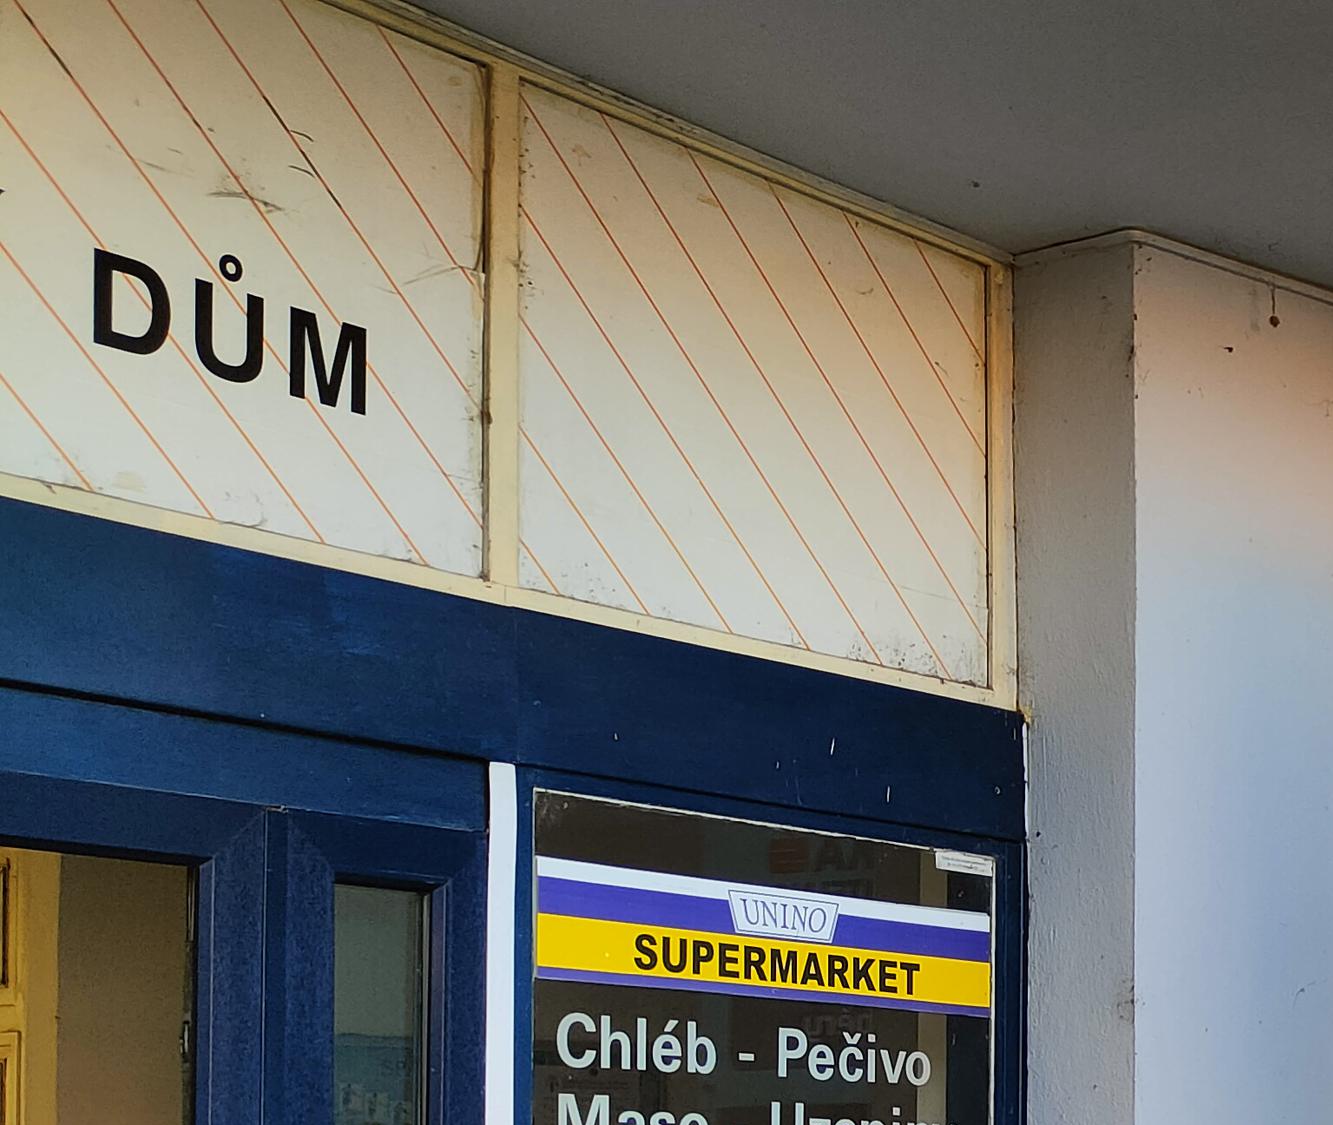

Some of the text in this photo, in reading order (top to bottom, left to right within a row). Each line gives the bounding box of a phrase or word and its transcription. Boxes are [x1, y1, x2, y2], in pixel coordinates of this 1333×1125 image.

[94, 247, 367, 416] DŮM
[740, 898, 828, 934] UNINO
[634, 933, 920, 996] SUPERMARKET
[555, 1012, 717, 1075] Chléb
[777, 1027, 931, 1087] Pečivo
